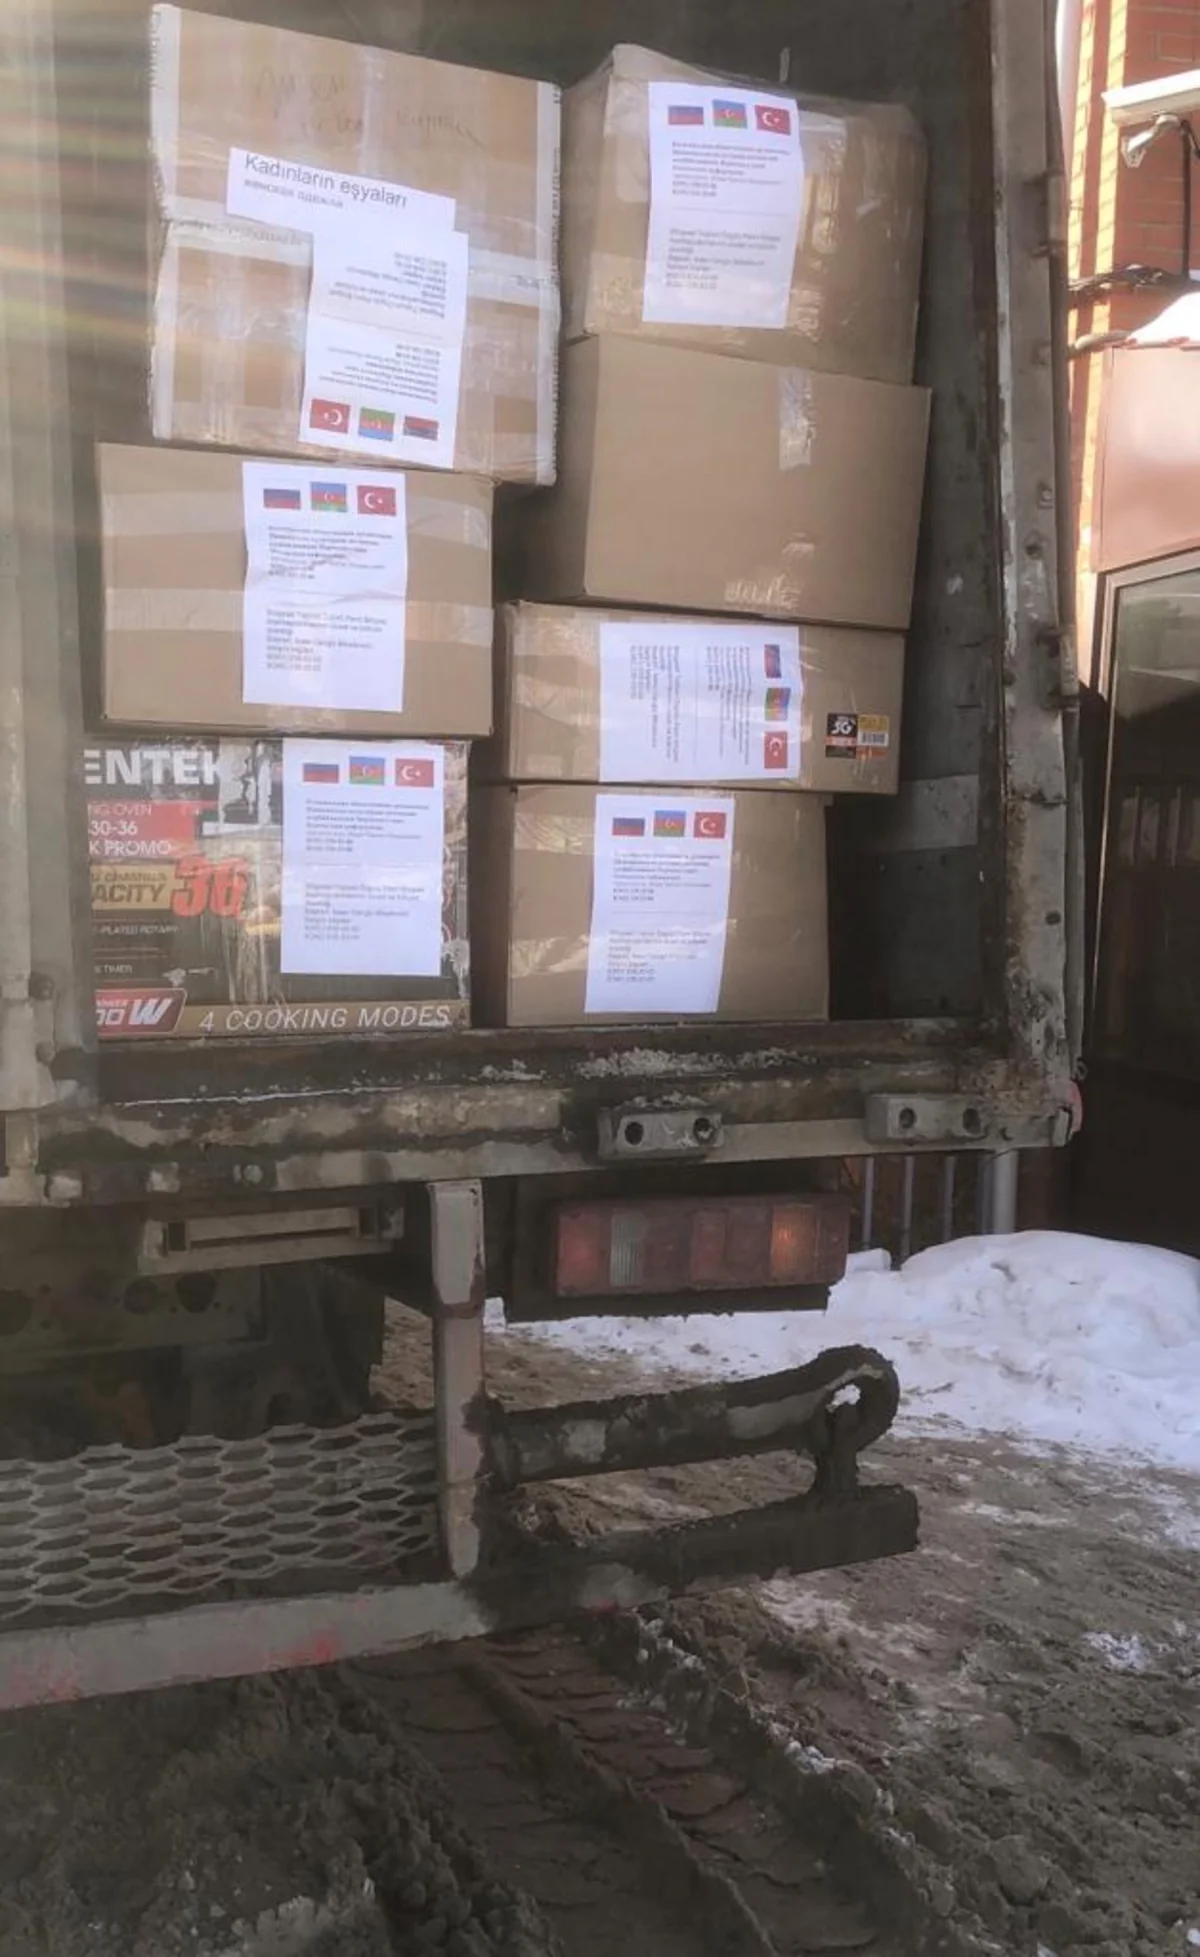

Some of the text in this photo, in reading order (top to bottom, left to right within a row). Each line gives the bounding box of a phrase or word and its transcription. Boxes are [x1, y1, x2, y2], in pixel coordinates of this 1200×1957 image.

[244, 152, 408, 209] Kadınların eşyaları
[104, 839, 172, 856] PROMO
[198, 1004, 453, 1032] 4 COOKING MODES
